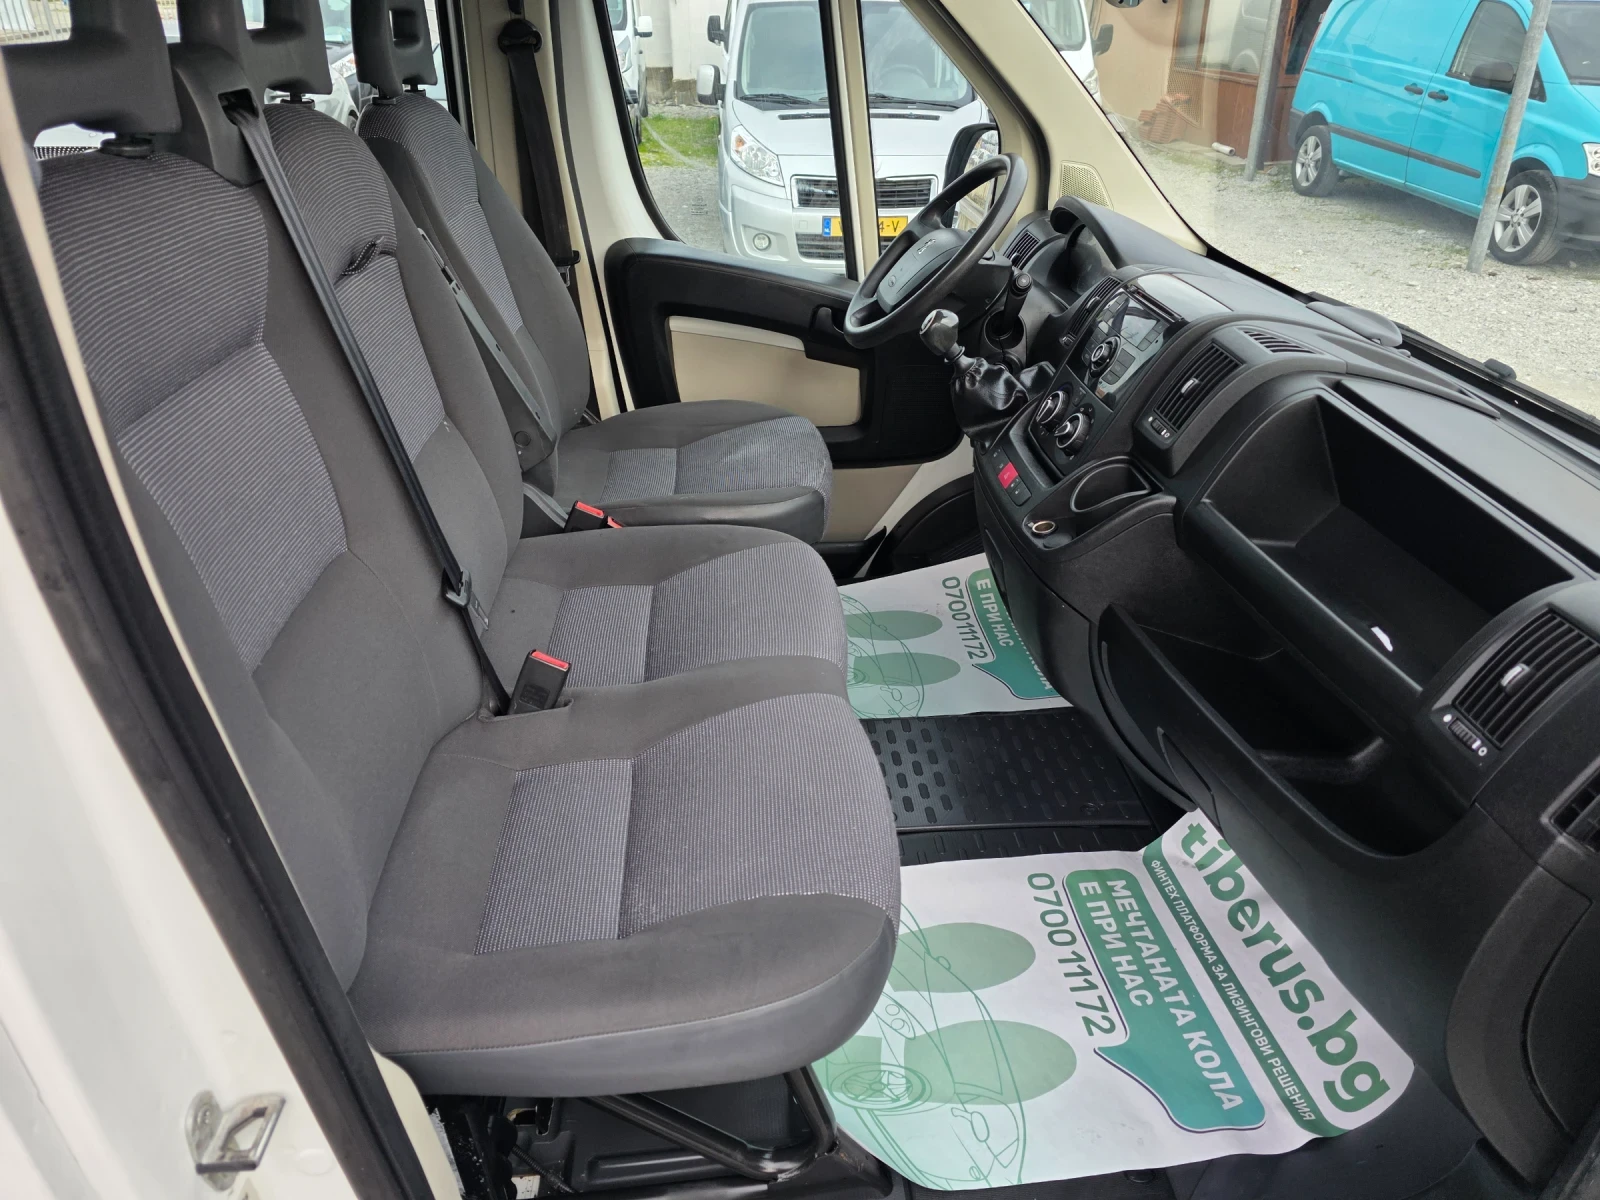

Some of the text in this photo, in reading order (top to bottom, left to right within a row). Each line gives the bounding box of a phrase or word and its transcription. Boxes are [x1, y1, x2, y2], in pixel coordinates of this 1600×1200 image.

[942, 576, 988, 660] 070011172
[976, 578, 1014, 647] Е ПРИ НАС
[1027, 872, 1116, 1037] 070011172
[1078, 881, 1154, 1007] Е ПРИ НАС
[1106, 879, 1244, 1110] МЕЧТАНАТА КОЛА
[1150, 859, 1316, 1121] ФИНТЕХ ПЛАТФОРМА ЗА ЛИЗИНГОВИ РЕШЕНИЯ
[1180, 822, 1391, 1113] tiberus.bg
